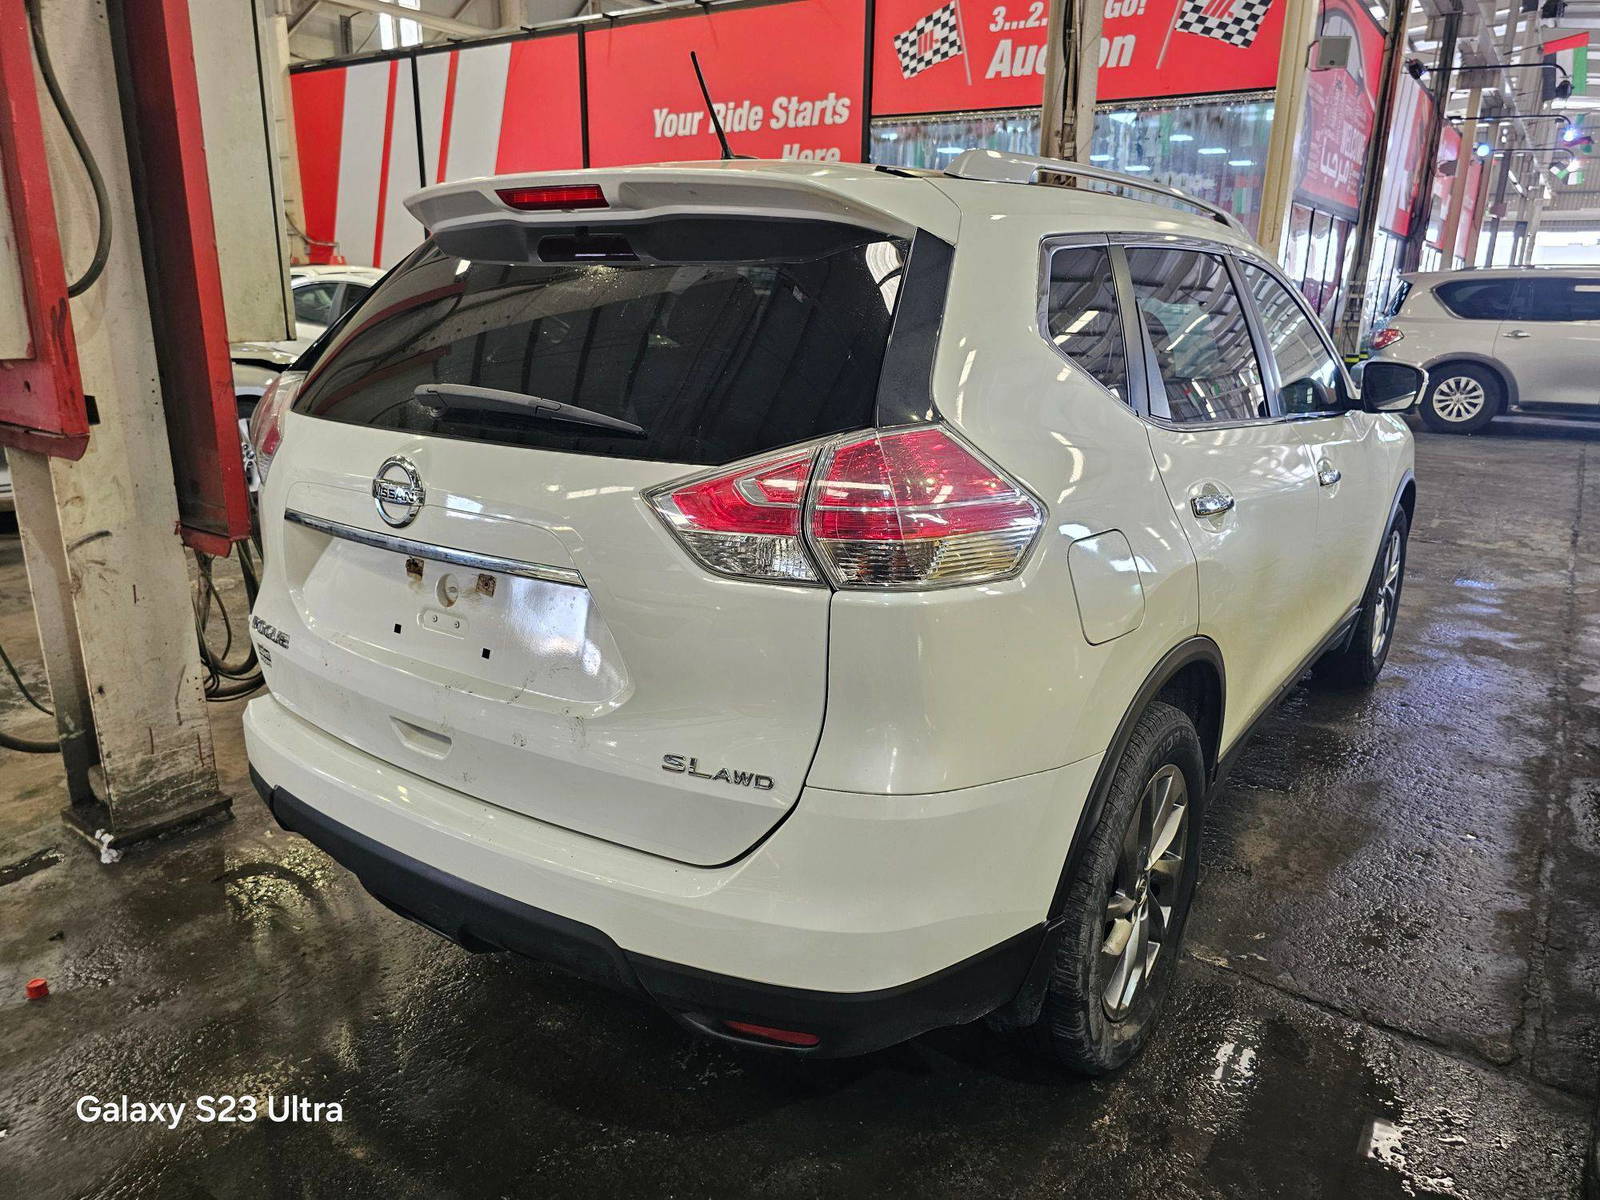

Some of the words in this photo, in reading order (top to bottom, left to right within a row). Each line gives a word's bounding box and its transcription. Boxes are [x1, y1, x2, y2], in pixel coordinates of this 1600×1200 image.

[653, 108, 705, 138] Your
[708, 100, 764, 134] Ride
[769, 92, 851, 130] Starts
[373, 481, 418, 504] NISSAN
[661, 754, 713, 780] SL
[711, 767, 776, 791] AWD
